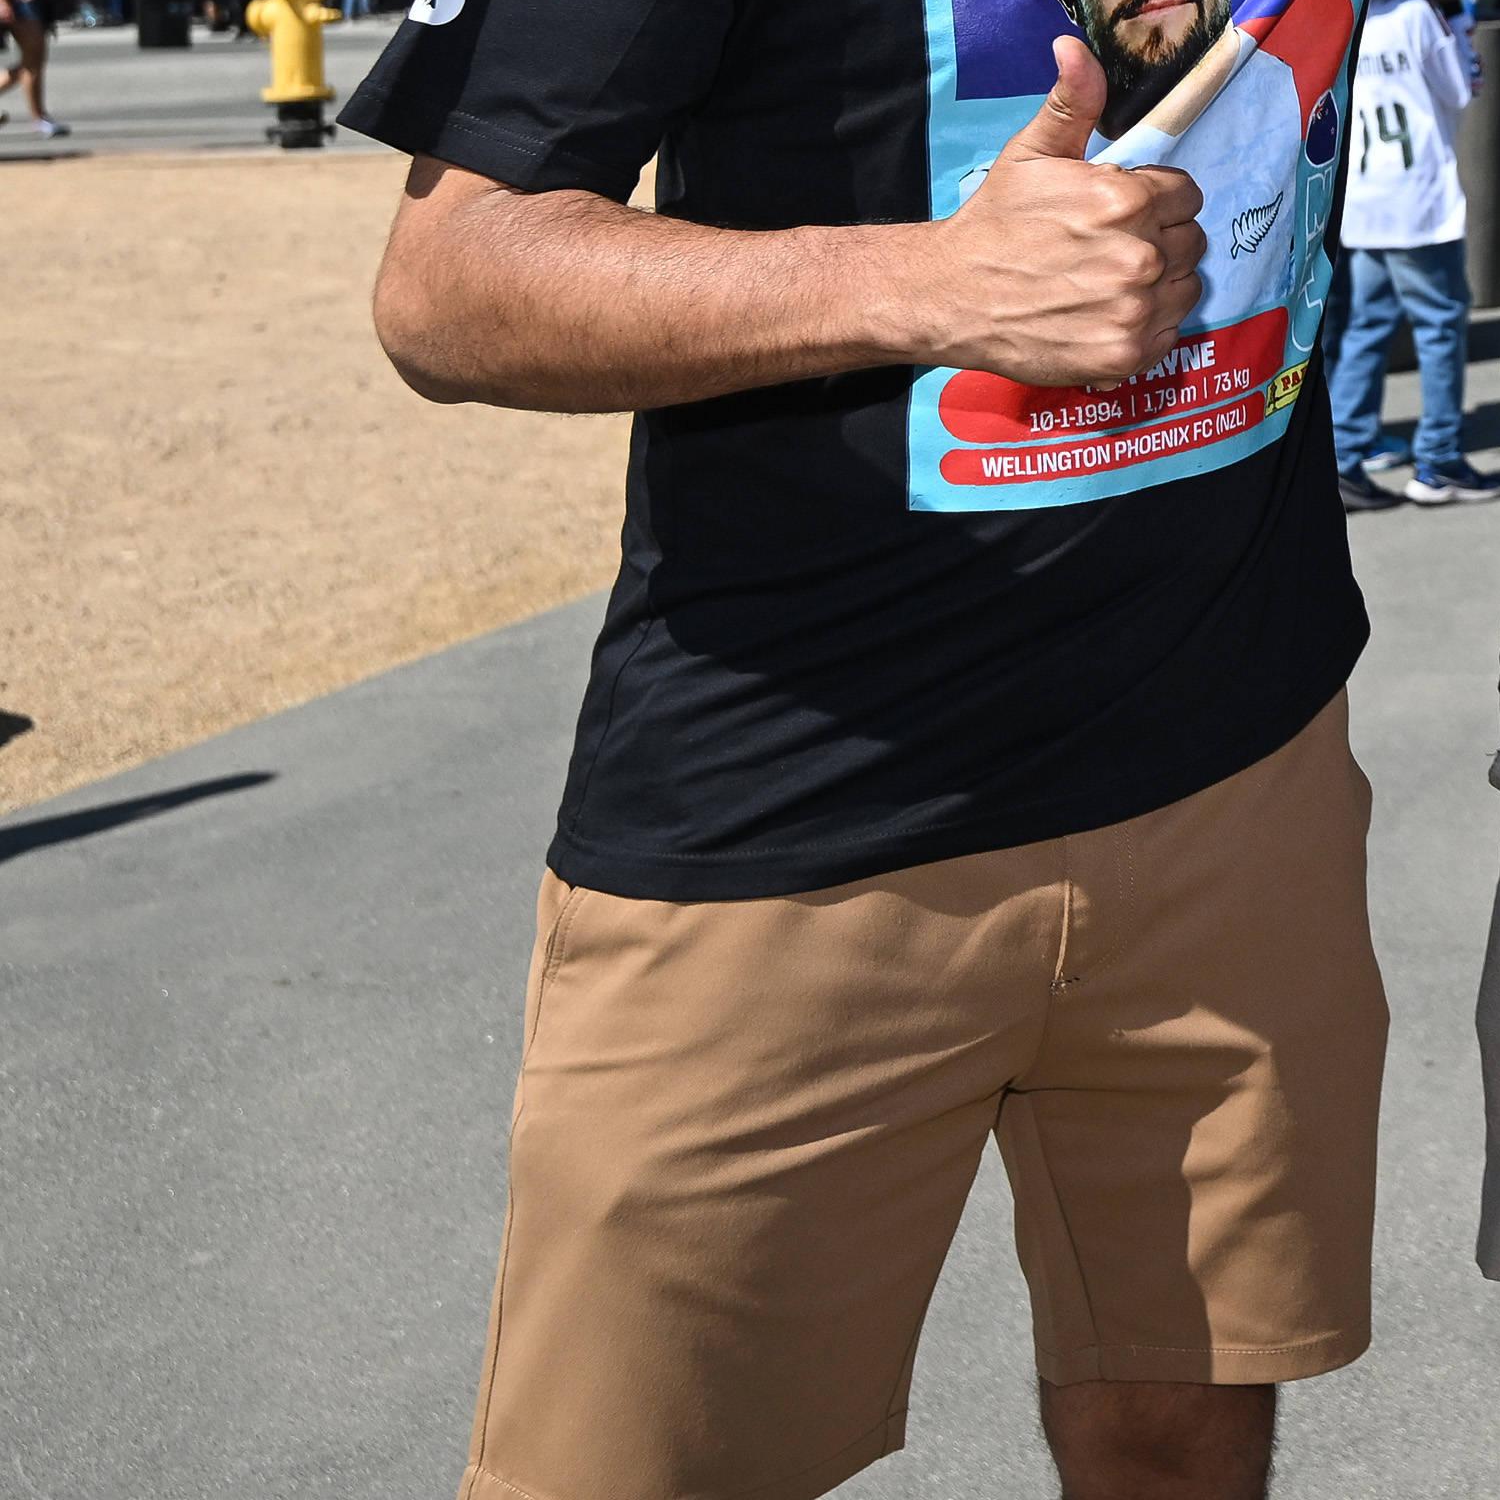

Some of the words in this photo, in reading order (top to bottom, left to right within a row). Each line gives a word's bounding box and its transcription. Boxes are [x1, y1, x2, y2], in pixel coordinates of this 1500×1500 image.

[1029, 400, 1124, 433] 10-1-1994
[1144, 387, 1177, 414] 1,79
[1180, 385, 1197, 405] m
[1213, 371, 1232, 395] 73
[1233, 367, 1250, 389] kg
[981, 443, 1111, 478] WELLINGTON
[1114, 424, 1190, 461] PHOENIX
[1193, 418, 1213, 442] FC
[1215, 404, 1247, 435] (NZL)
